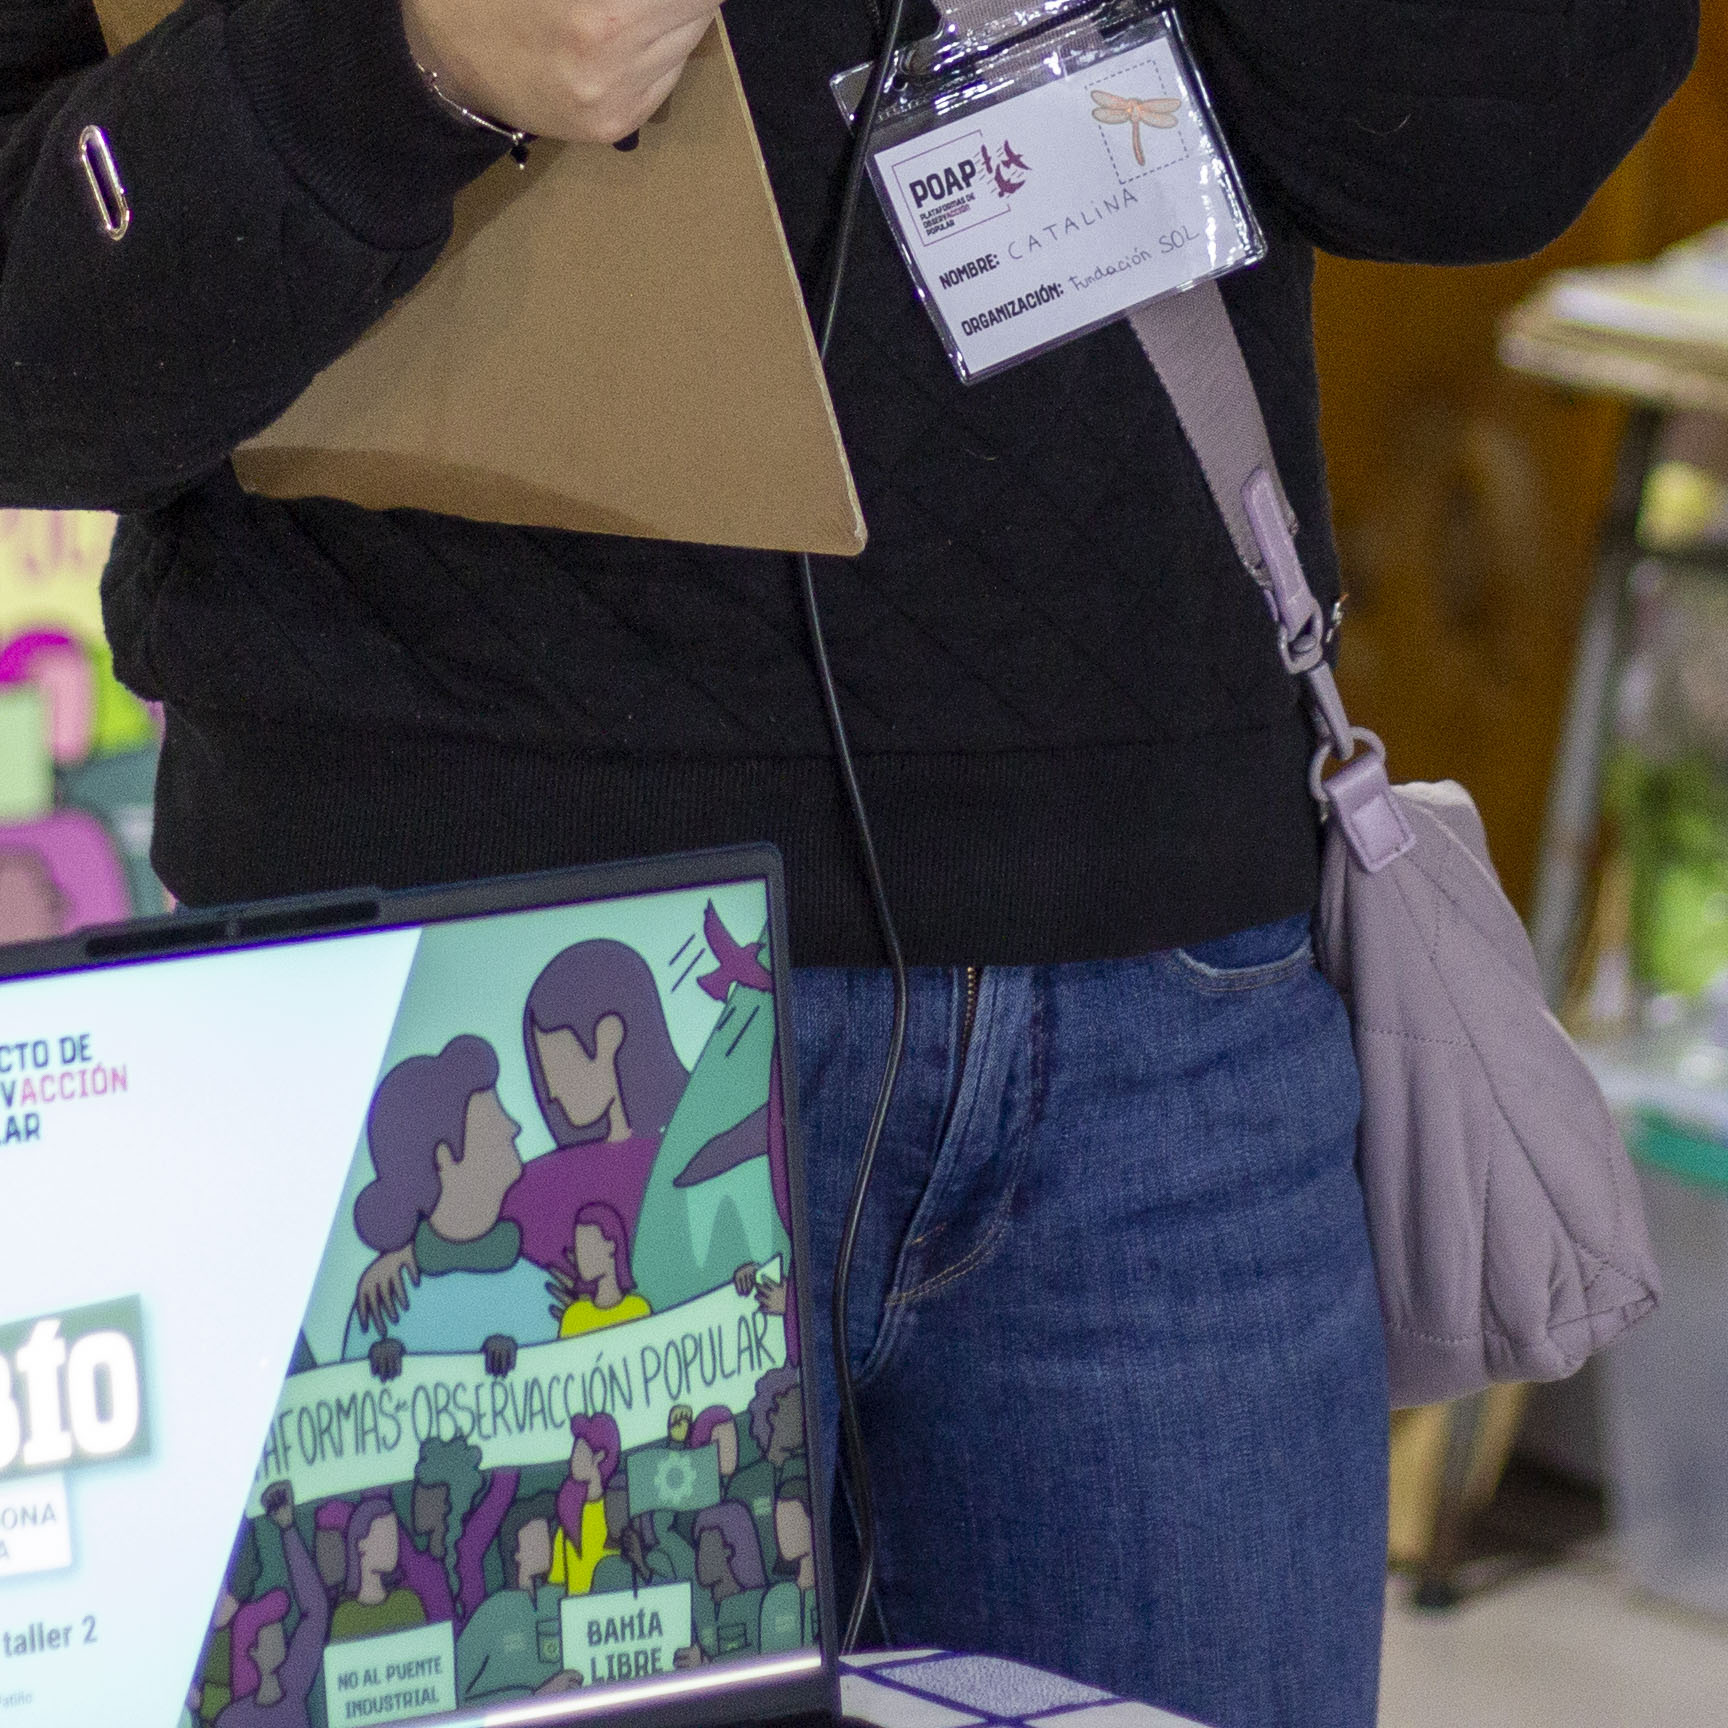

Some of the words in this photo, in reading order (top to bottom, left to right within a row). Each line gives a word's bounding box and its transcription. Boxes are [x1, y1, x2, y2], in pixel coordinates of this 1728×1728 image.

[909, 159, 976, 208] POAP
[939, 253, 1000, 290] NOMBRE:
[961, 283, 1065, 336] ORGANIZACIÓN:
[1158, 225, 1200, 254] SOL
[59, 1033, 93, 1066] DE
[642, 1312, 778, 1408] POPULAR
[3, 1622, 73, 1658] taller
[82, 1614, 98, 1645] 2
[586, 1606, 664, 1646] BAHÍA
[337, 1667, 359, 1691] NO
[363, 1665, 381, 1687] AL
[385, 1655, 443, 1682] PUENTE
[589, 1647, 665, 1684] LIBRE
[345, 1688, 440, 1720] INDUSTRIAL
